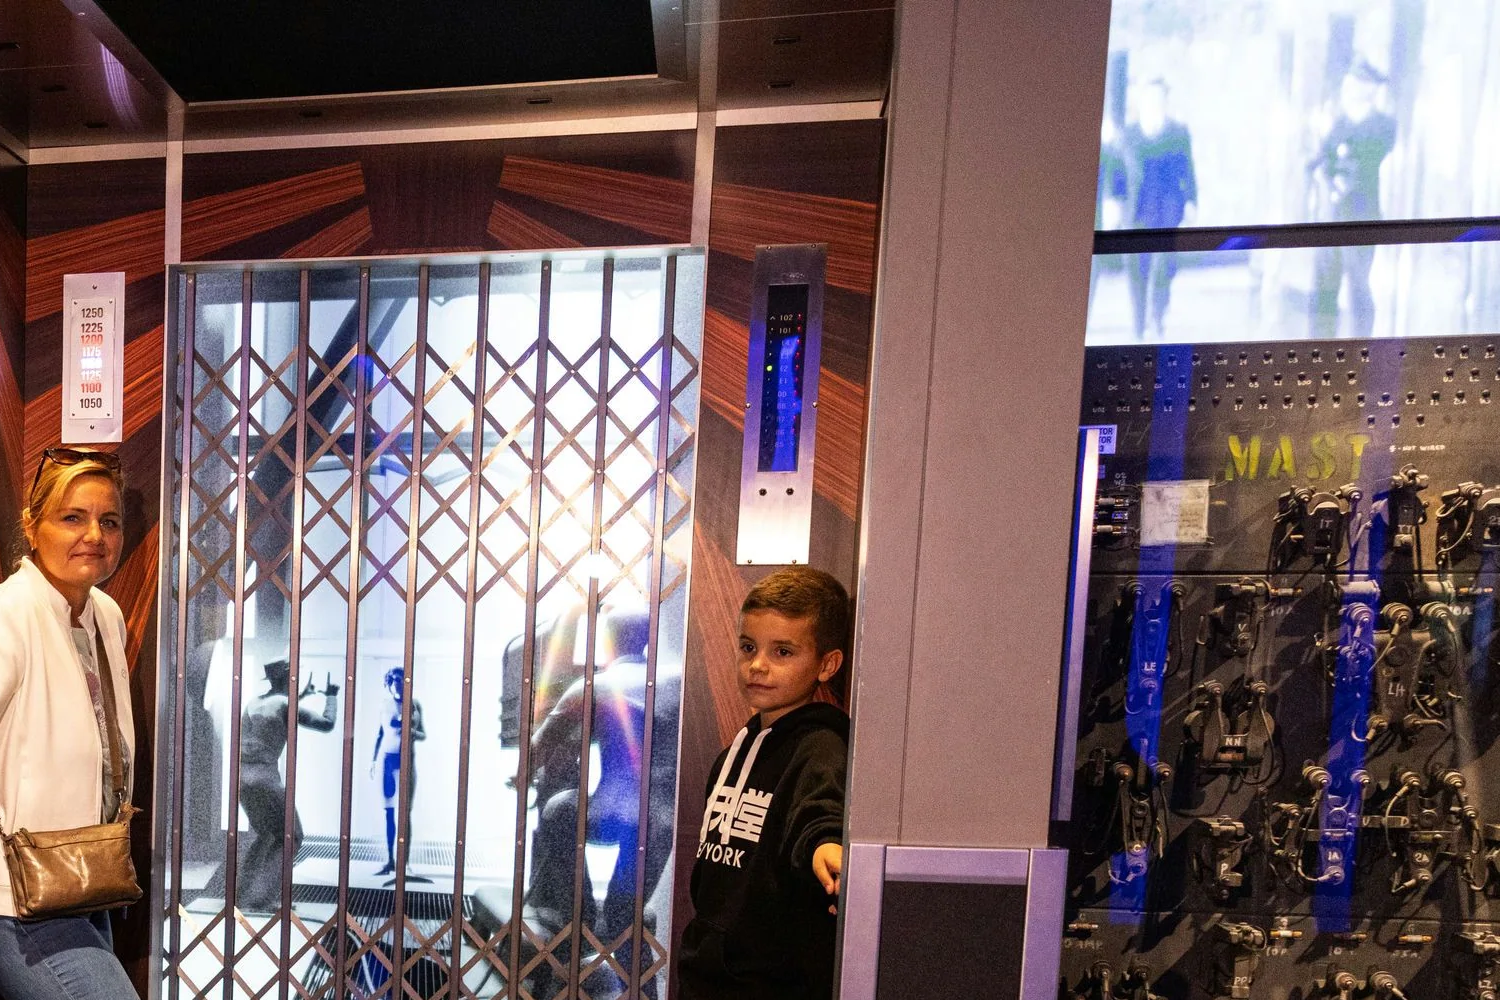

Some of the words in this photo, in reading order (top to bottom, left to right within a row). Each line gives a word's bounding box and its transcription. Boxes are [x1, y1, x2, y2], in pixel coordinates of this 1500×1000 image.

[81, 308, 103, 318] 1250
[81, 323, 103, 333] 1225
[80, 334, 103, 345] 1200
[80, 383, 102, 393] 1100
[80, 398, 102, 408] 1050
[1225, 432, 1371, 480] MAST
